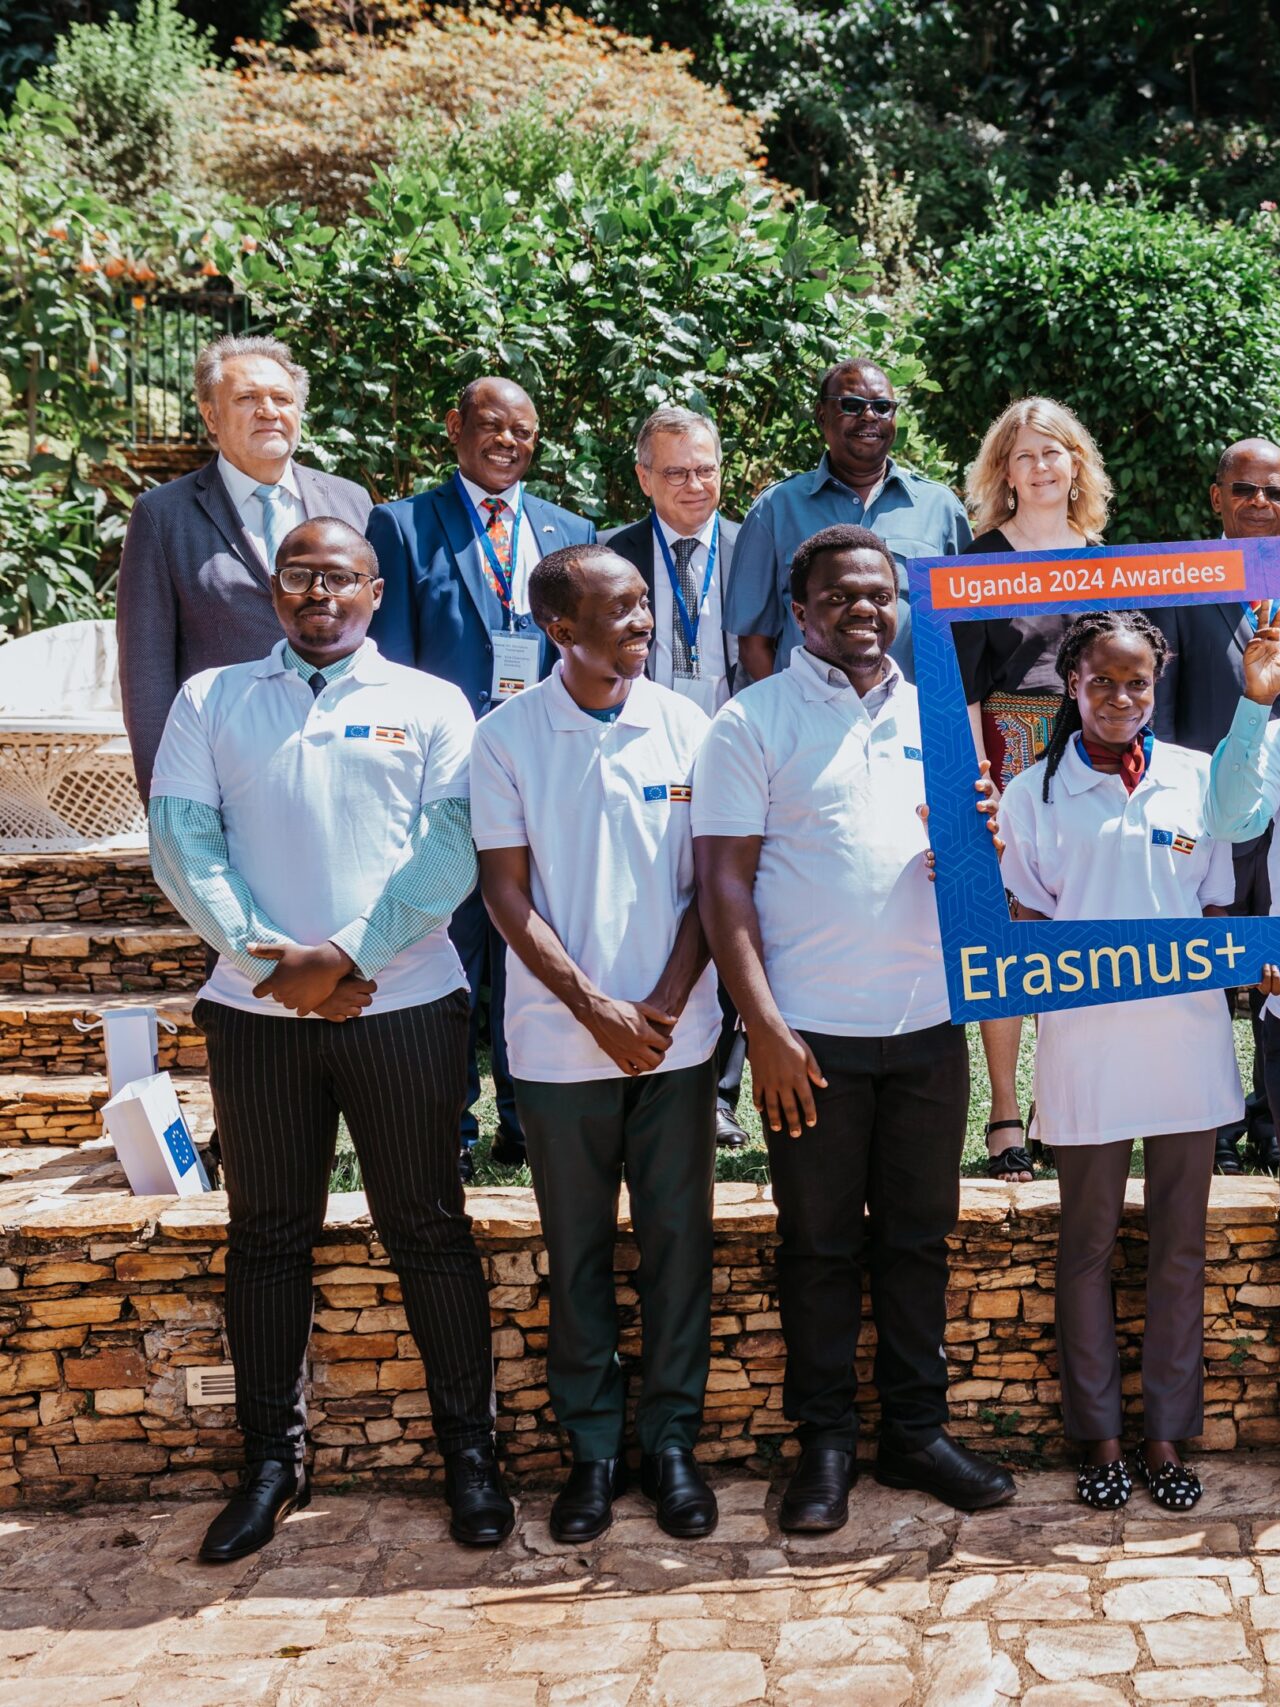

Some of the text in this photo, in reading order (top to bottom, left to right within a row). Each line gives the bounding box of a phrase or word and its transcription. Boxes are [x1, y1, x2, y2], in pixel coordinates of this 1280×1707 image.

[949, 562, 1226, 604] Uganda 2024 Awardees
[960, 932, 1246, 1000] Erasmus+
